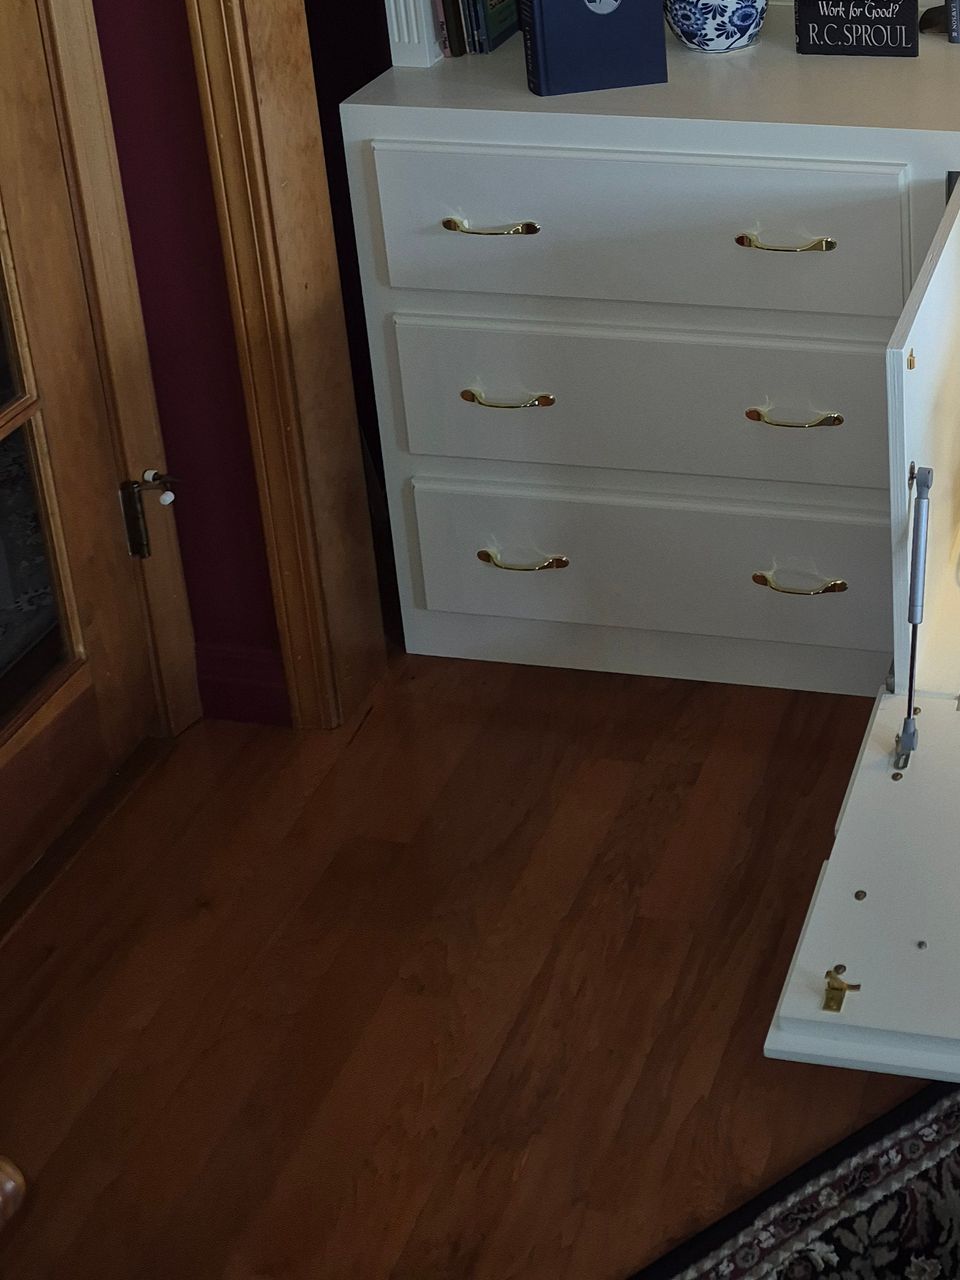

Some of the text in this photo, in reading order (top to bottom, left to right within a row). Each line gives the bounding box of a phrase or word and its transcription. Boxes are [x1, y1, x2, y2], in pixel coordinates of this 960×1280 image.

[818, 0, 900, 20] Work for Good?
[842, 24, 913, 48] SPROUL
